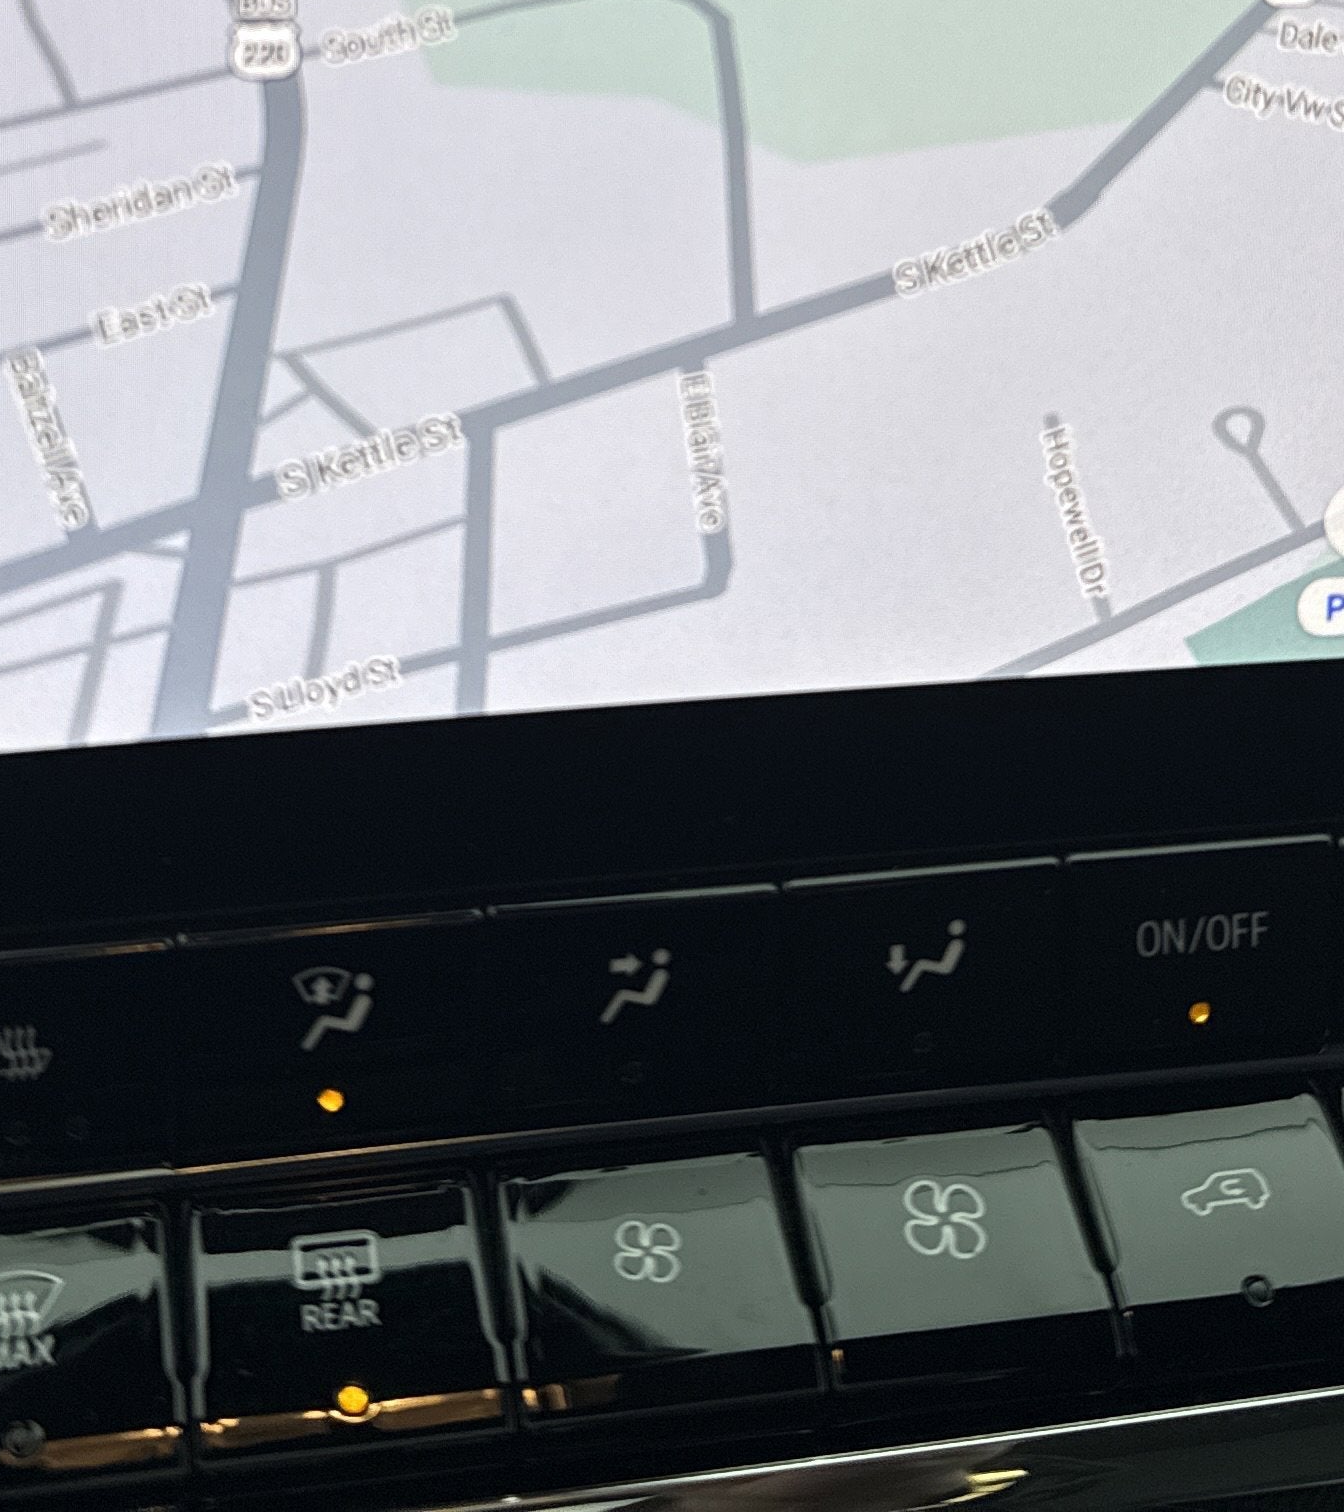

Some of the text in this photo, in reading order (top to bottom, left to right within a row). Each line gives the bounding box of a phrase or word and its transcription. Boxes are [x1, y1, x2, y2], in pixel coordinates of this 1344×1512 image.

[242, 40, 290, 67] 220
[322, 6, 453, 62] South St
[1279, 21, 1337, 52] Dale
[1224, 76, 1277, 115] City
[1285, 92, 1324, 119] Vw
[47, 165, 235, 239] Sheridan St
[894, 210, 1056, 295] S Kettle St
[96, 285, 211, 345] East St
[281, 413, 462, 496] S Kettle St
[1044, 428, 1106, 597] Hopewell Dr
[250, 654, 401, 720] S Lloyd St
[1135, 909, 1269, 958] ON/OFF
[299, 1297, 381, 1334] REAR
